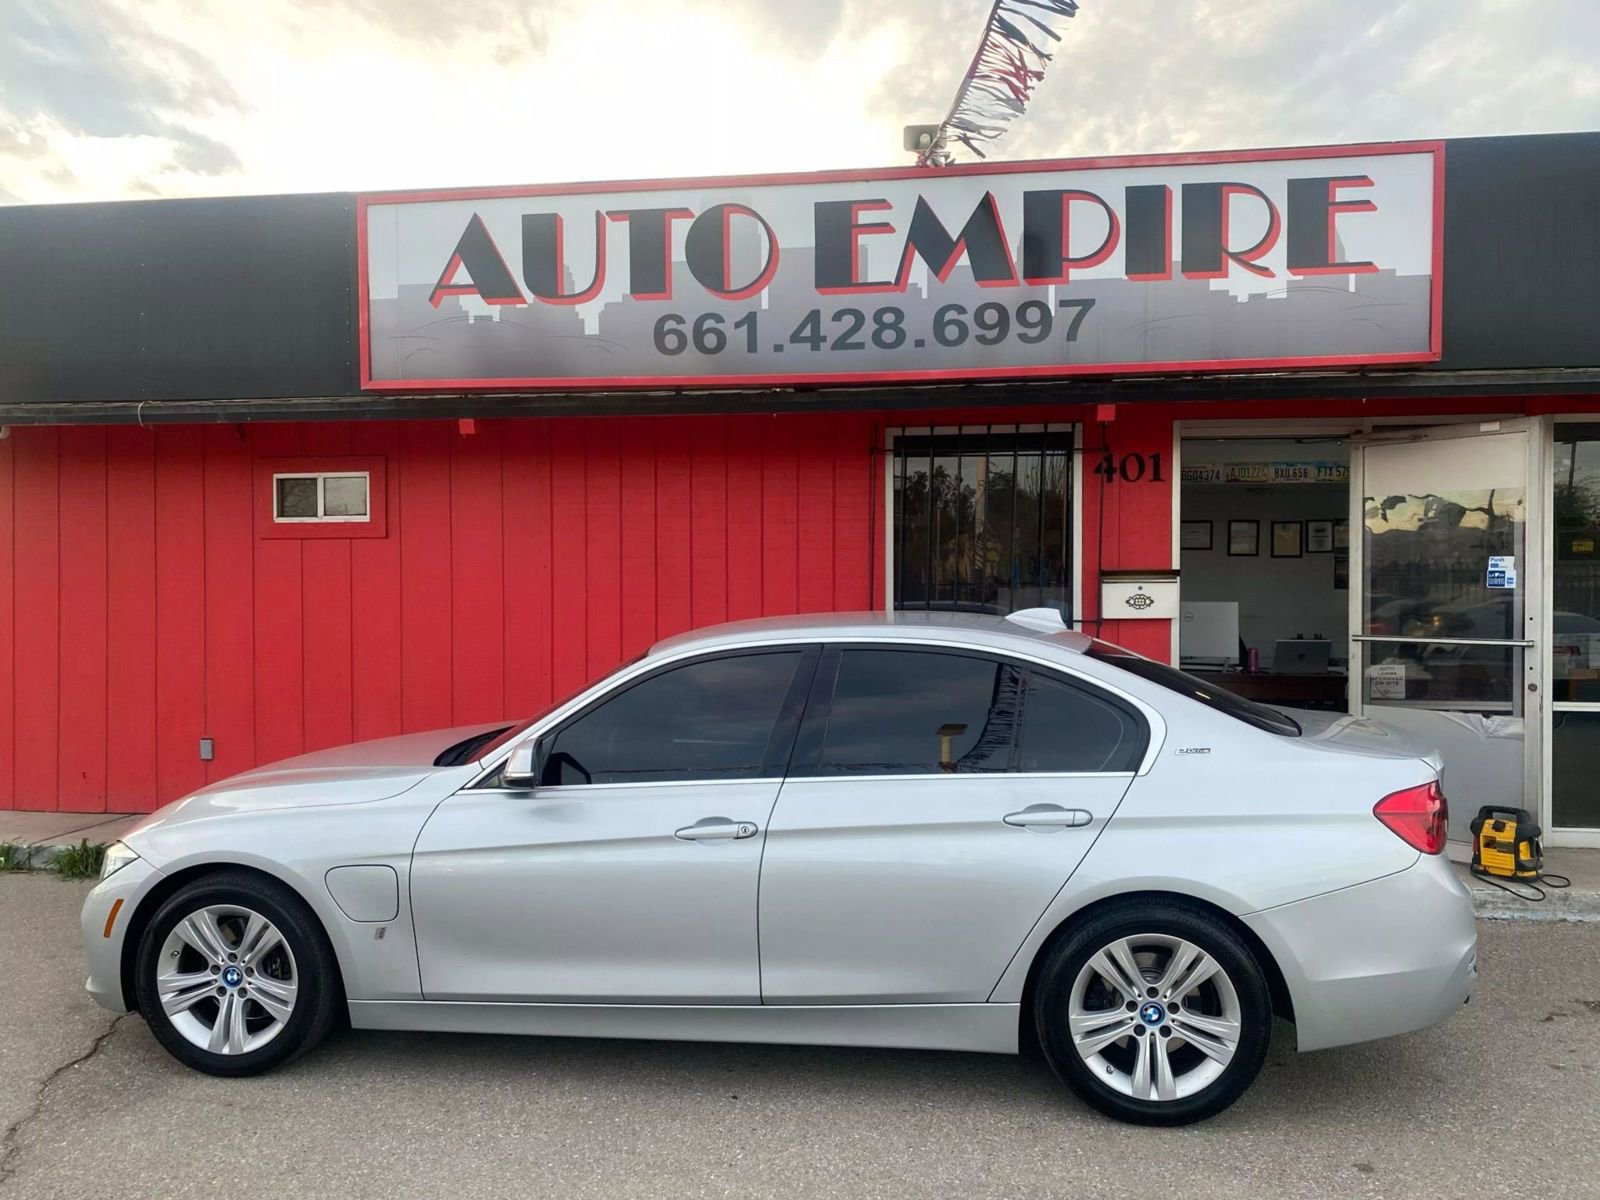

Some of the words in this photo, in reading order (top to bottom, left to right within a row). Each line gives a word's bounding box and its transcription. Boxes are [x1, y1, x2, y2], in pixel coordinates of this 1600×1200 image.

[428, 203, 779, 308] AUTO
[814, 175, 1380, 295] EMPIRE
[653, 298, 1096, 356] 661.428.6997
[1094, 453, 1166, 483] 401
